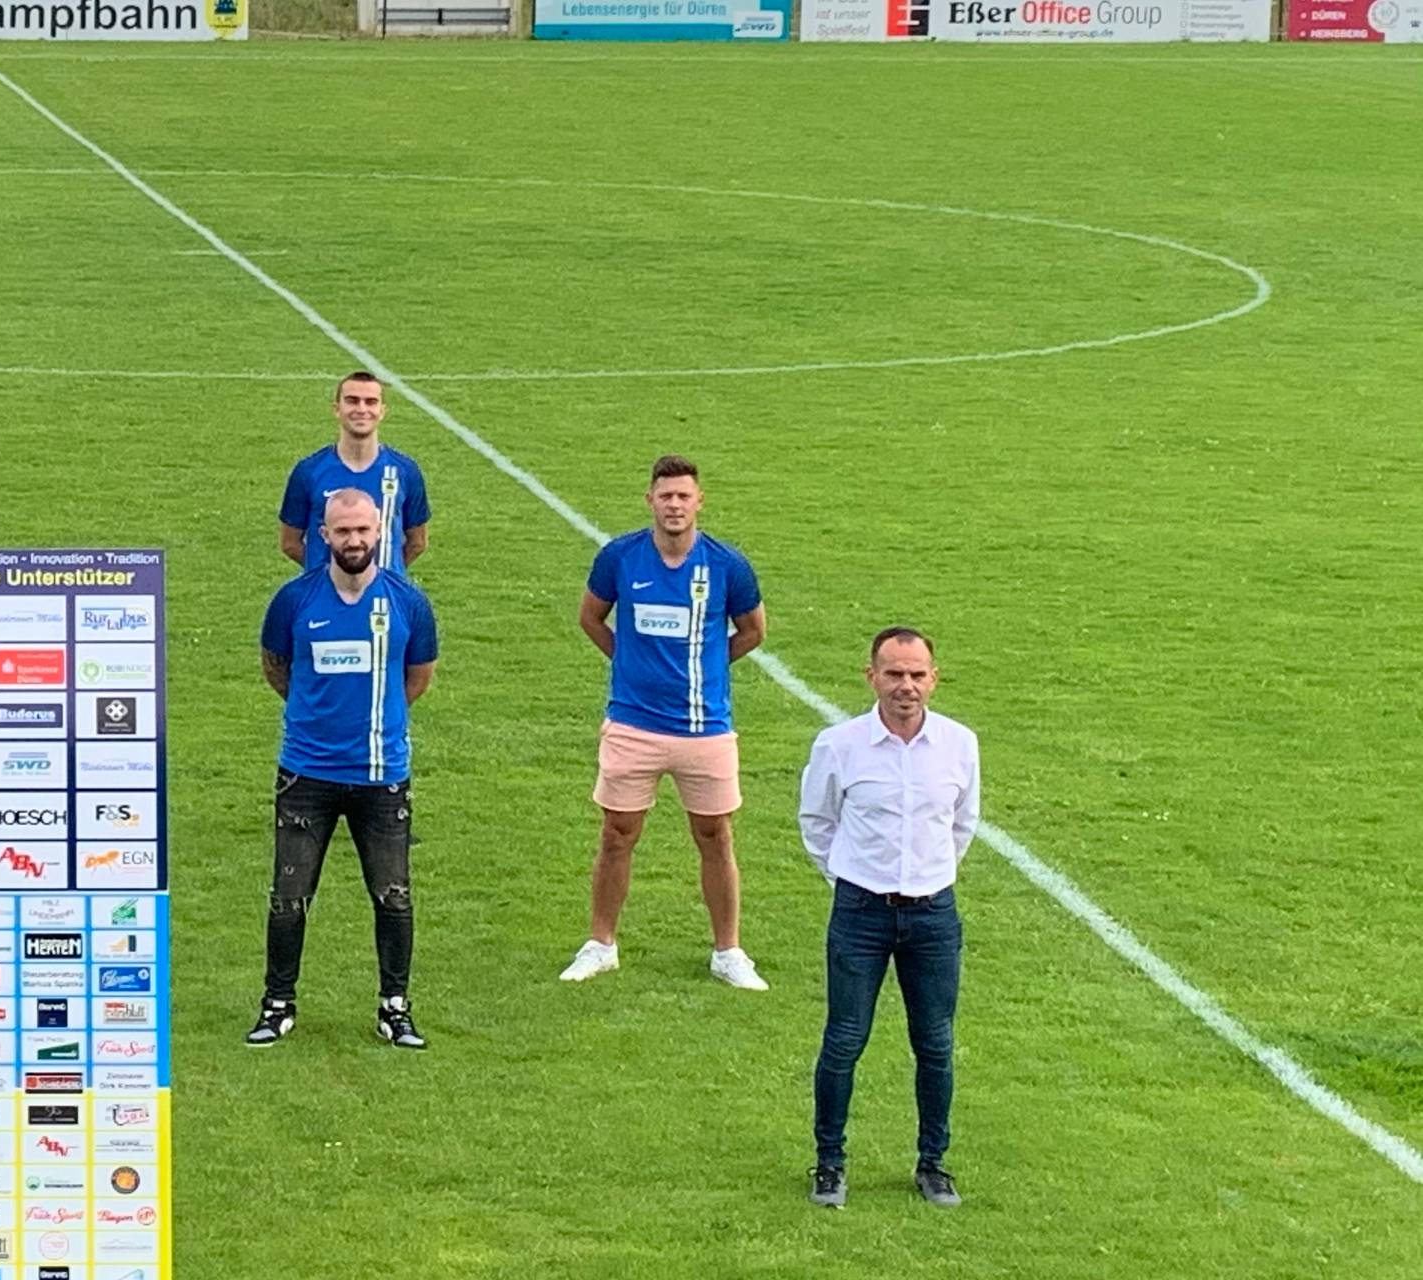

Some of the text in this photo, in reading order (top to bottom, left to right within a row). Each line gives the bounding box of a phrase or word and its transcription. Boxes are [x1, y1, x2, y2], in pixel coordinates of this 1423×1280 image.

[562, 1, 727, 19] Lebensenergie für Düren
[948, 1, 1162, 29] Eßer Office Group
[30, 553, 94, 565] Innovation
[105, 552, 159, 565] Tradition
[6, 567, 136, 587] Unterstützer
[320, 656, 361, 666] SWD
[2, 760, 52, 770] SWD
[122, 851, 154, 865] EGN
[27, 938, 82, 956] HERTEN
